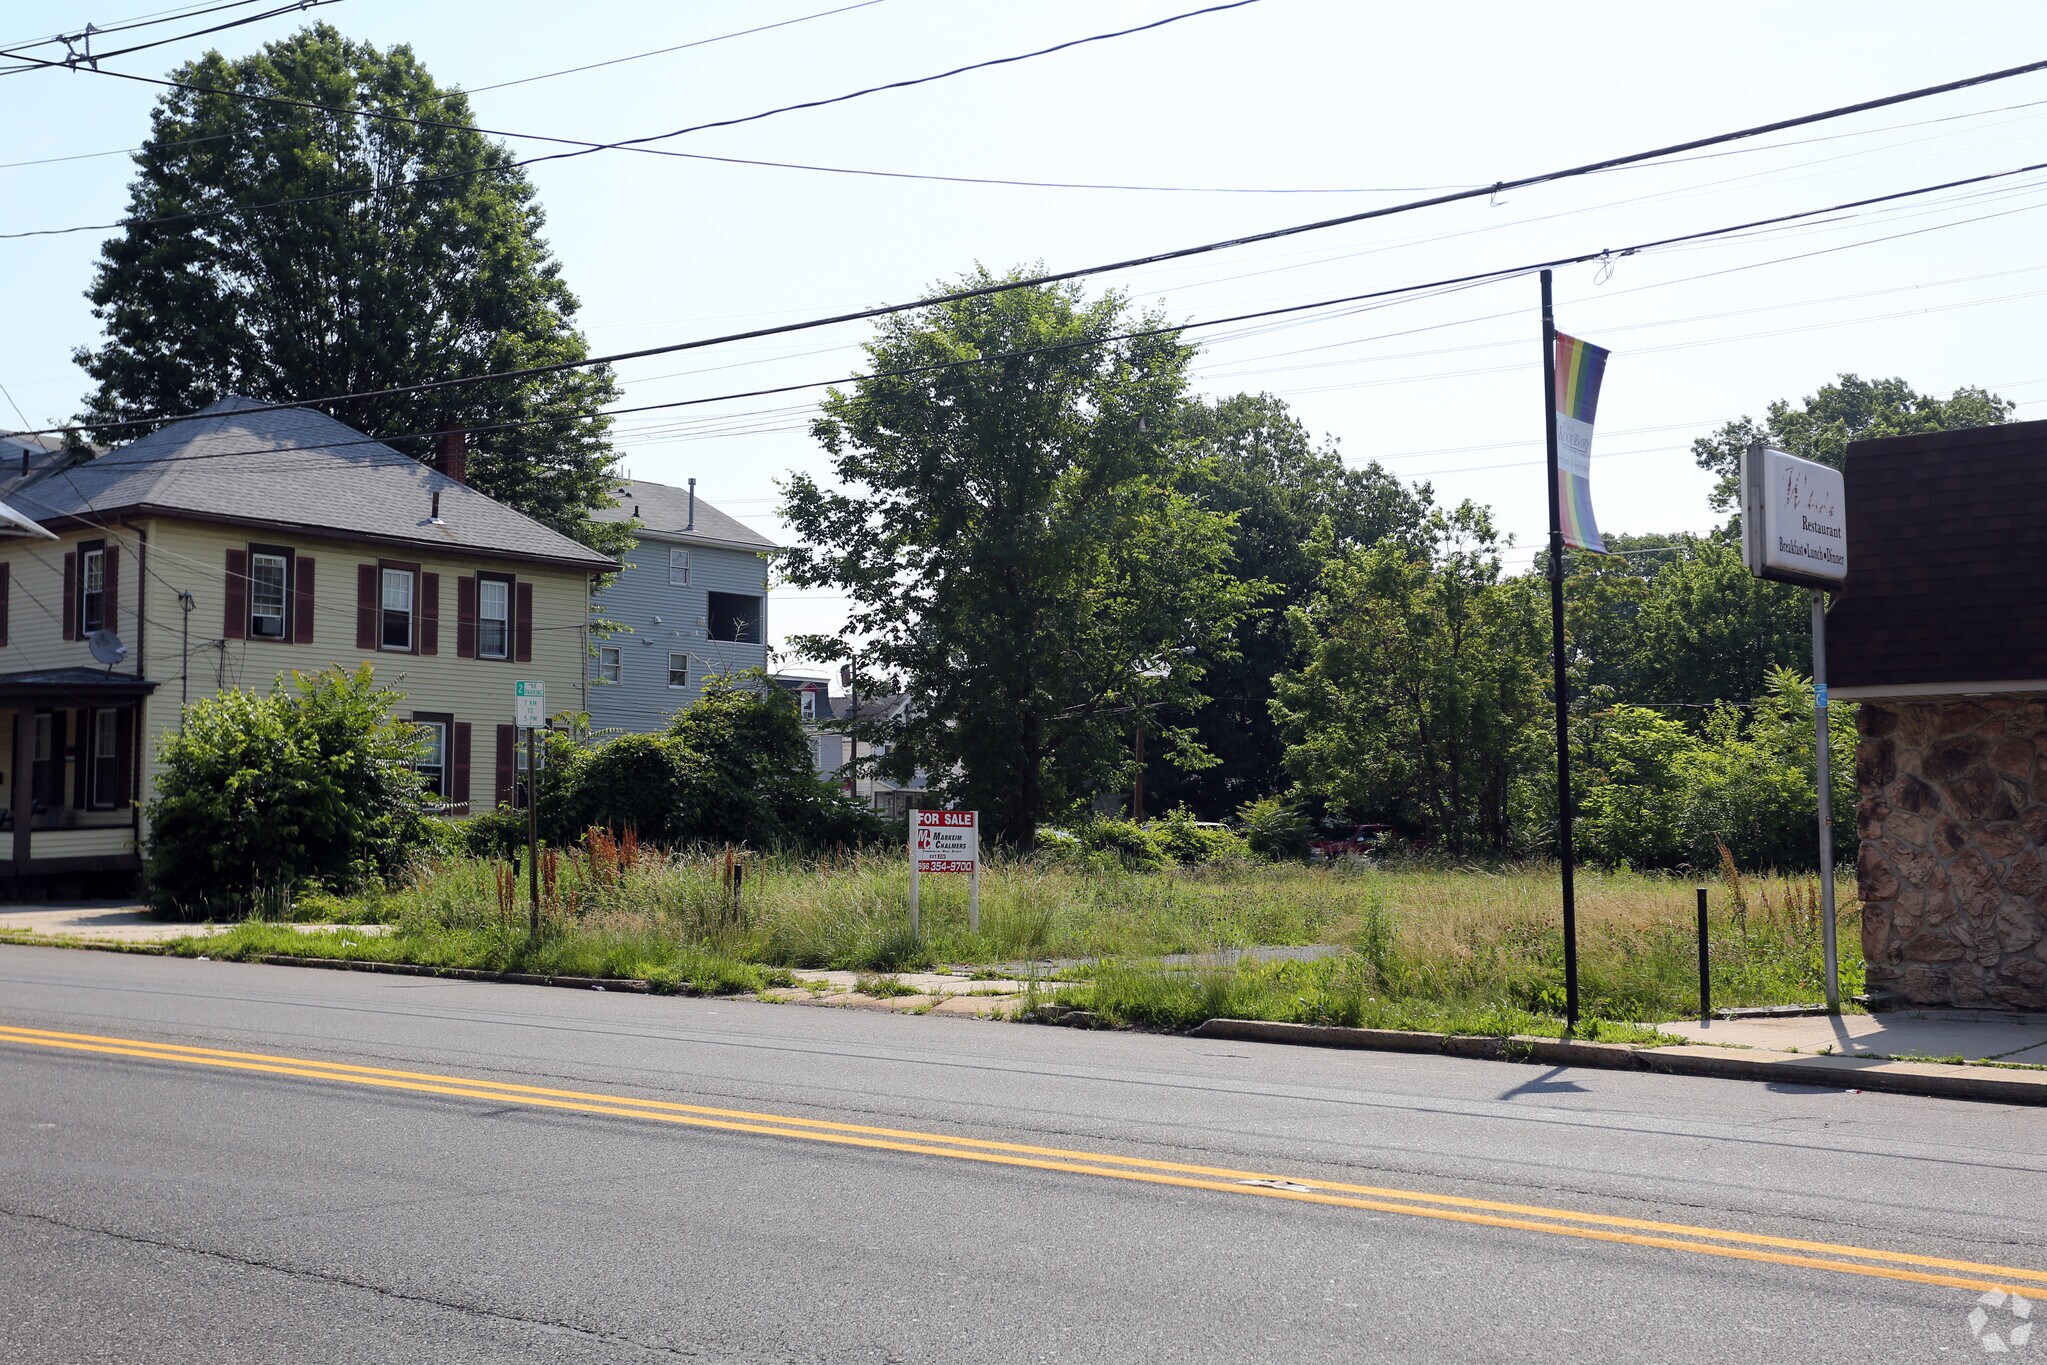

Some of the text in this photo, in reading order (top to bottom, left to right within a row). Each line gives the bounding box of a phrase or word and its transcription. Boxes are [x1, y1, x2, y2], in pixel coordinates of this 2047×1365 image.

[1801, 515, 1842, 539] Restaurant
[1779, 536, 1845, 565] Breakfast Lunch Dinner
[518, 684, 523, 694] 2
[918, 813, 971, 825] FOR SALE
[933, 832, 962, 841] MARKEIM
[935, 841, 967, 849] CHALMERS
[930, 861, 971, 871] 354-9700
